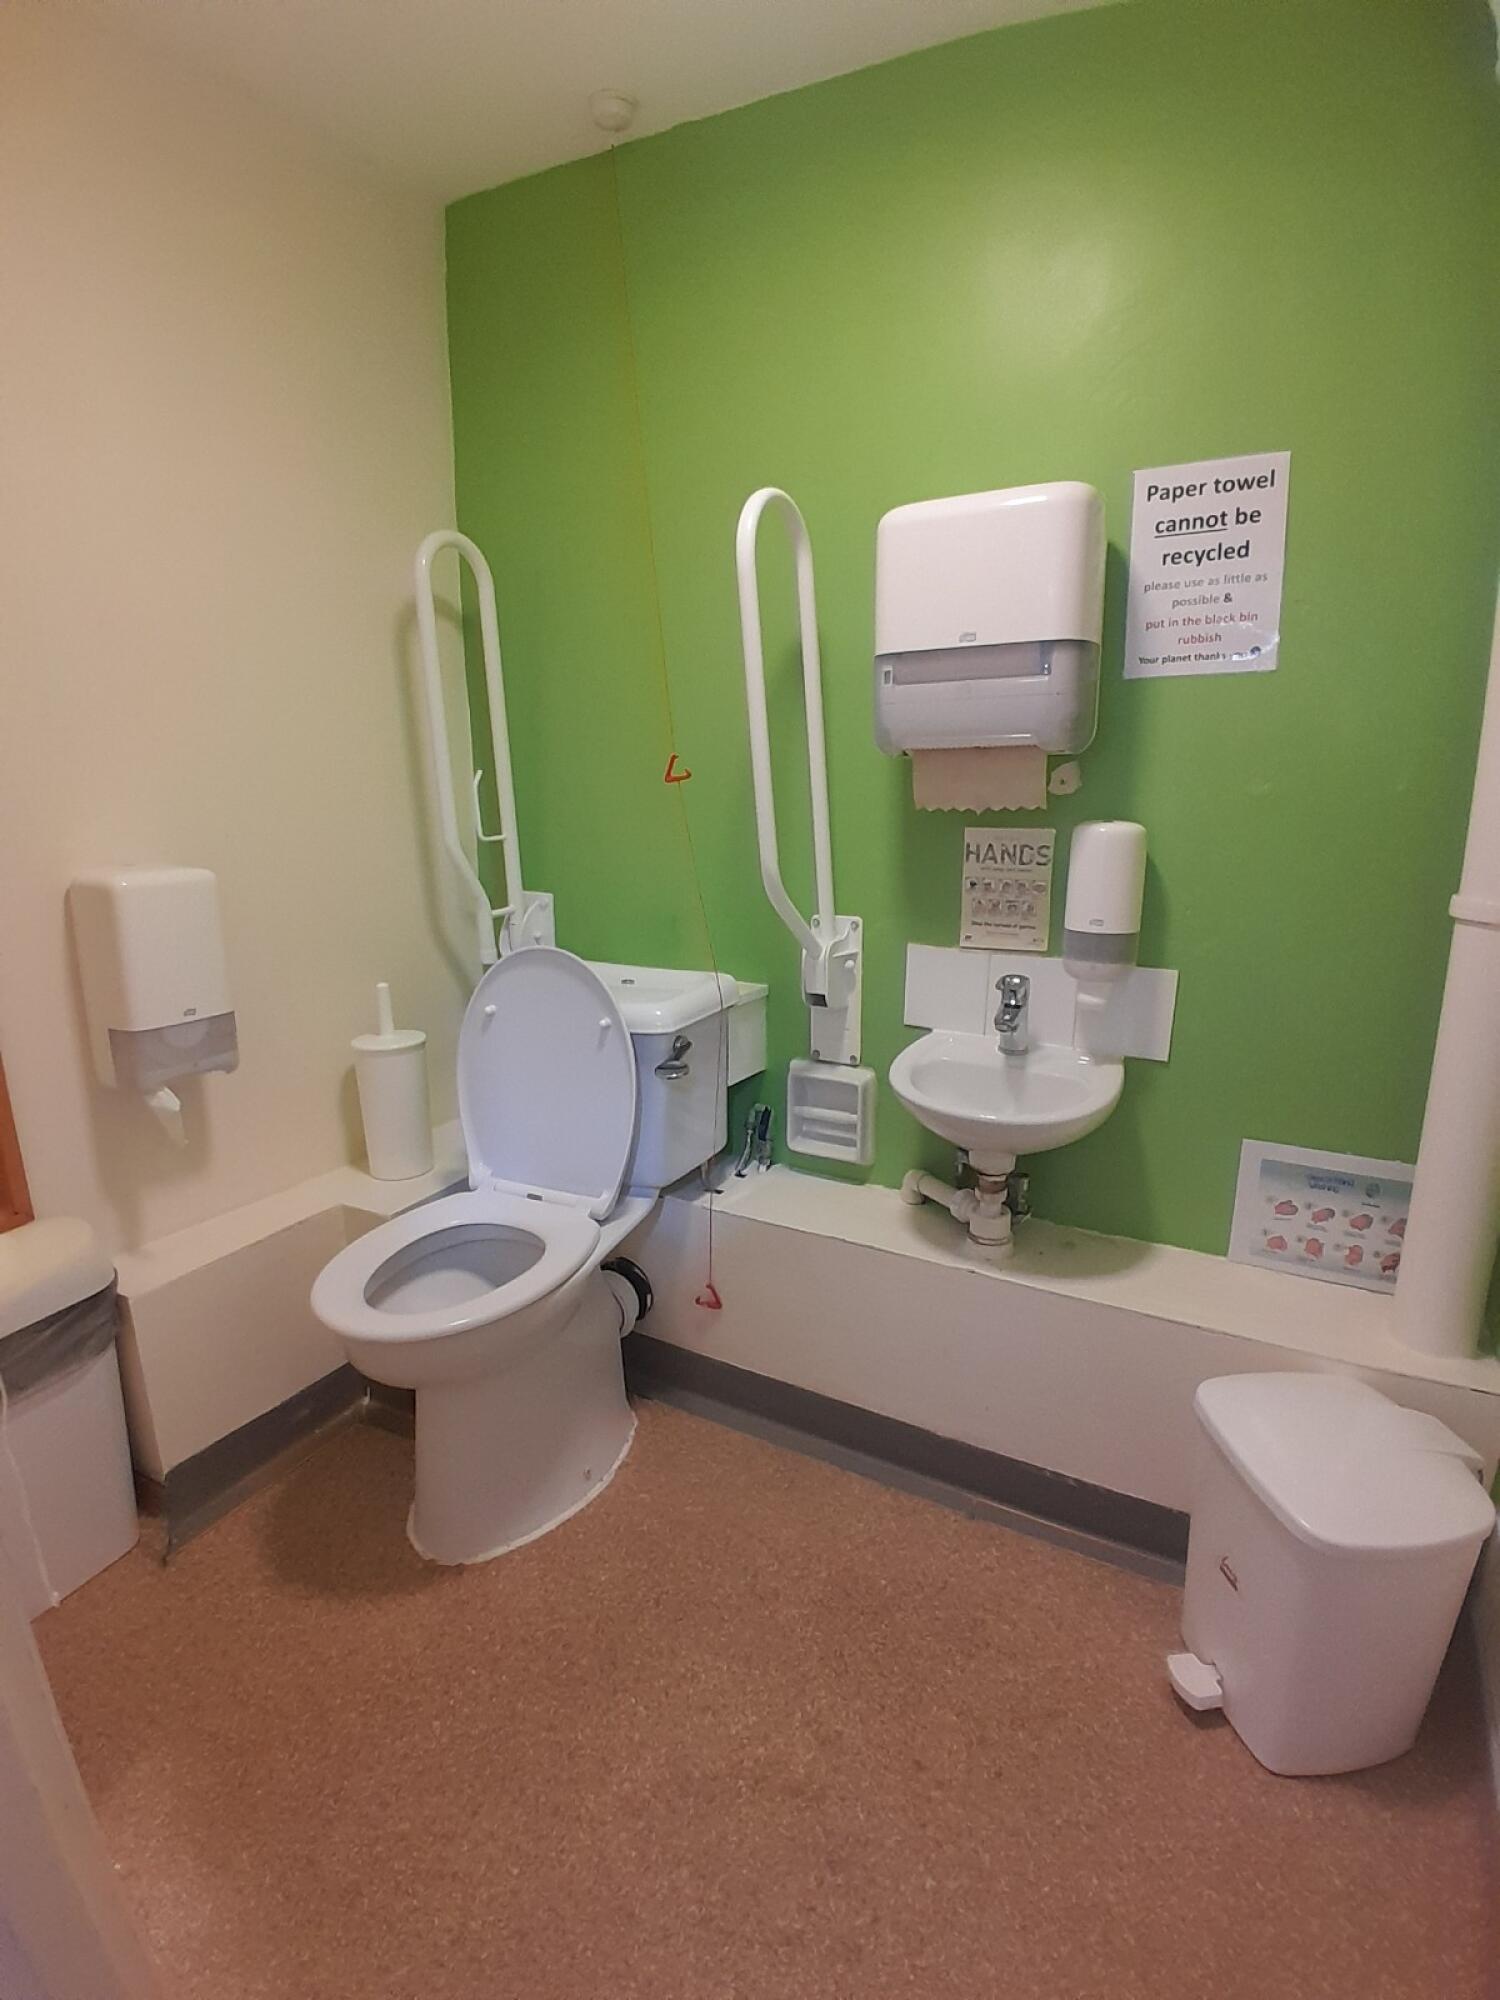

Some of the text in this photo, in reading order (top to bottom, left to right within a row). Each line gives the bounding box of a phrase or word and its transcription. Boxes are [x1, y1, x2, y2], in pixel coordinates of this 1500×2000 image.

[1146, 468, 1275, 503] Paper towel
[1154, 507, 1261, 535] cannot be
[1162, 539, 1250, 567] recycled
[1143, 572, 1268, 593] please use as little as
[1171, 592, 1233, 609] possible &
[1145, 611, 1258, 632] put in the black bin
[1177, 632, 1223, 645] rubbish
[1161, 653, 1192, 665] planet
[965, 842, 1052, 866] HANDS
